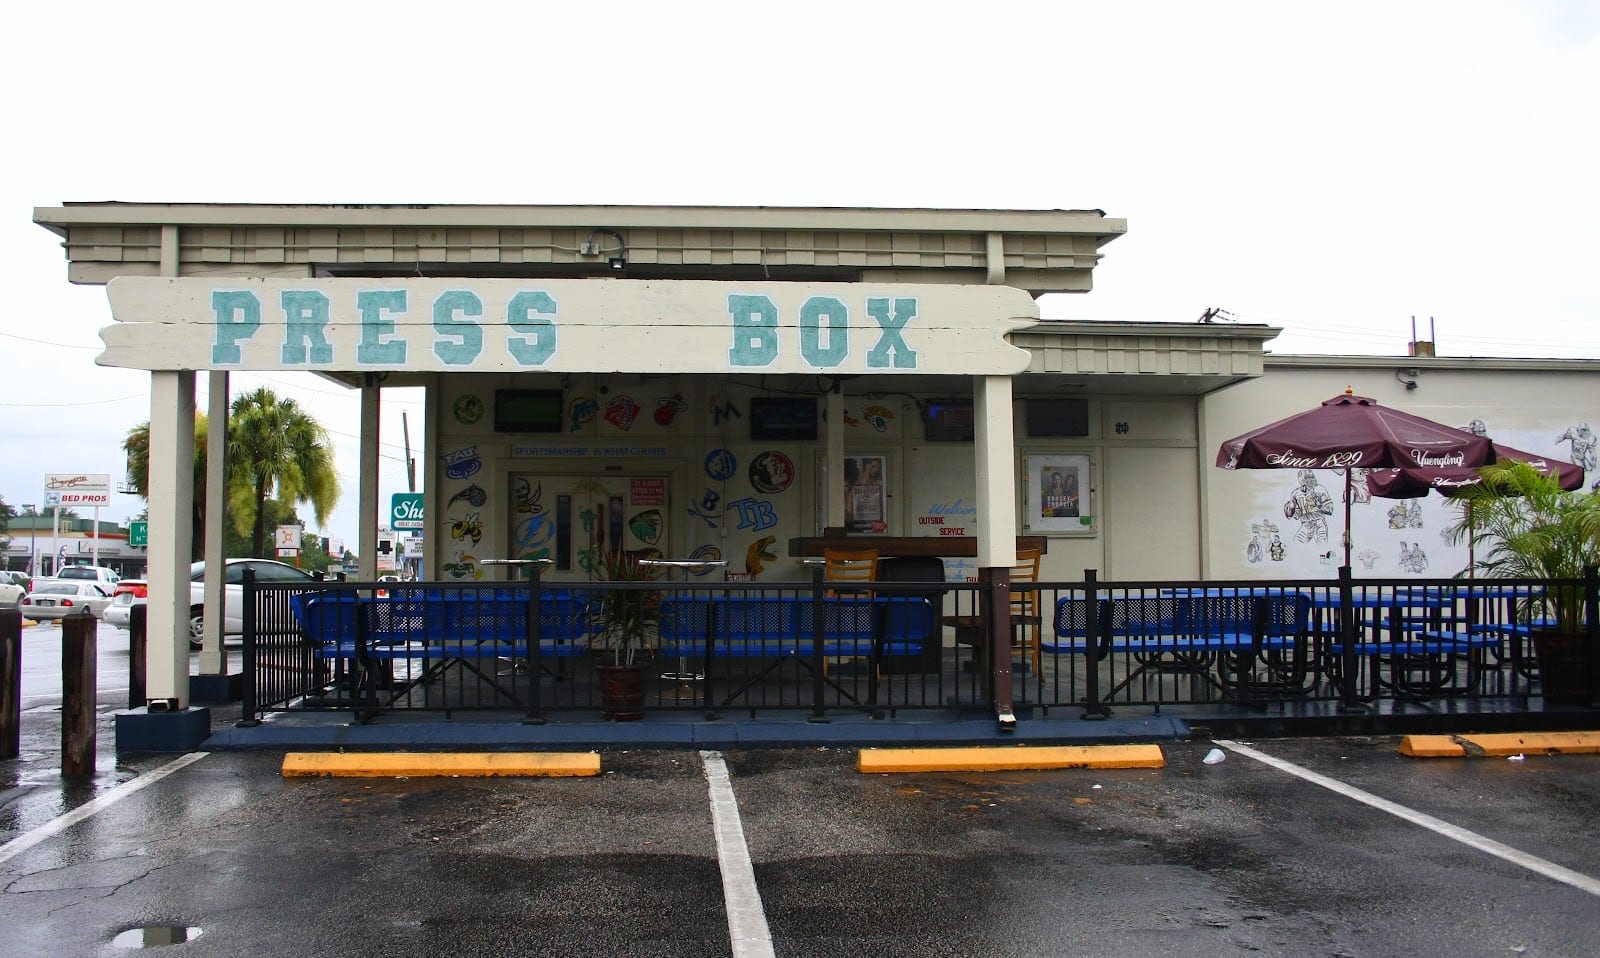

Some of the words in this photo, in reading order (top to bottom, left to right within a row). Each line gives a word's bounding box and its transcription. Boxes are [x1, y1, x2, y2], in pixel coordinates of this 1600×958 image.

[211, 288, 558, 366] PRESS
[727, 292, 919, 369] BOX
[514, 447, 588, 456] SPORTSMANSHIP
[603, 447, 628, 456] WHAT
[630, 447, 667, 456] COUNTS
[1265, 449, 1317, 467] Since
[1320, 450, 1363, 467] 1829
[1411, 448, 1465, 468] Yuengling
[727, 497, 778, 532] TB
[918, 516, 945, 525] OUTSIDE
[939, 527, 965, 536] SERVICE
